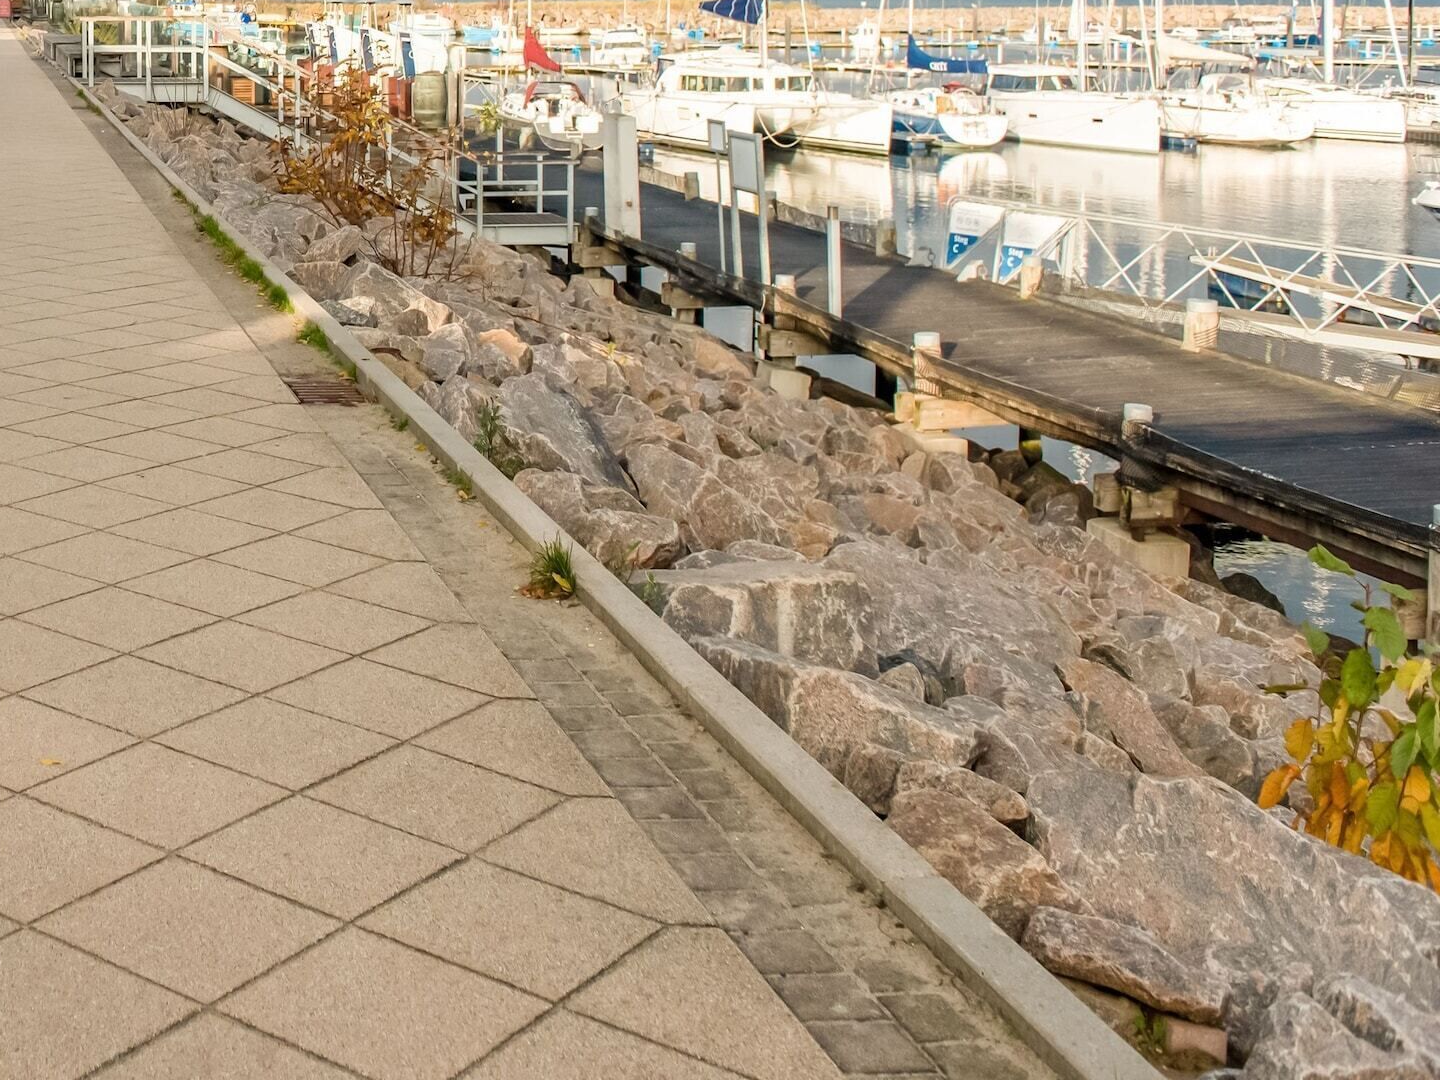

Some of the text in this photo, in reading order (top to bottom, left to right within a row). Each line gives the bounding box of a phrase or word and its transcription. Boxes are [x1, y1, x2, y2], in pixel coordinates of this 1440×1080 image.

[953, 235, 969, 246] Steg
[952, 244, 960, 253] C
[1007, 247, 1024, 259] Steg
[1006, 257, 1015, 267] C
